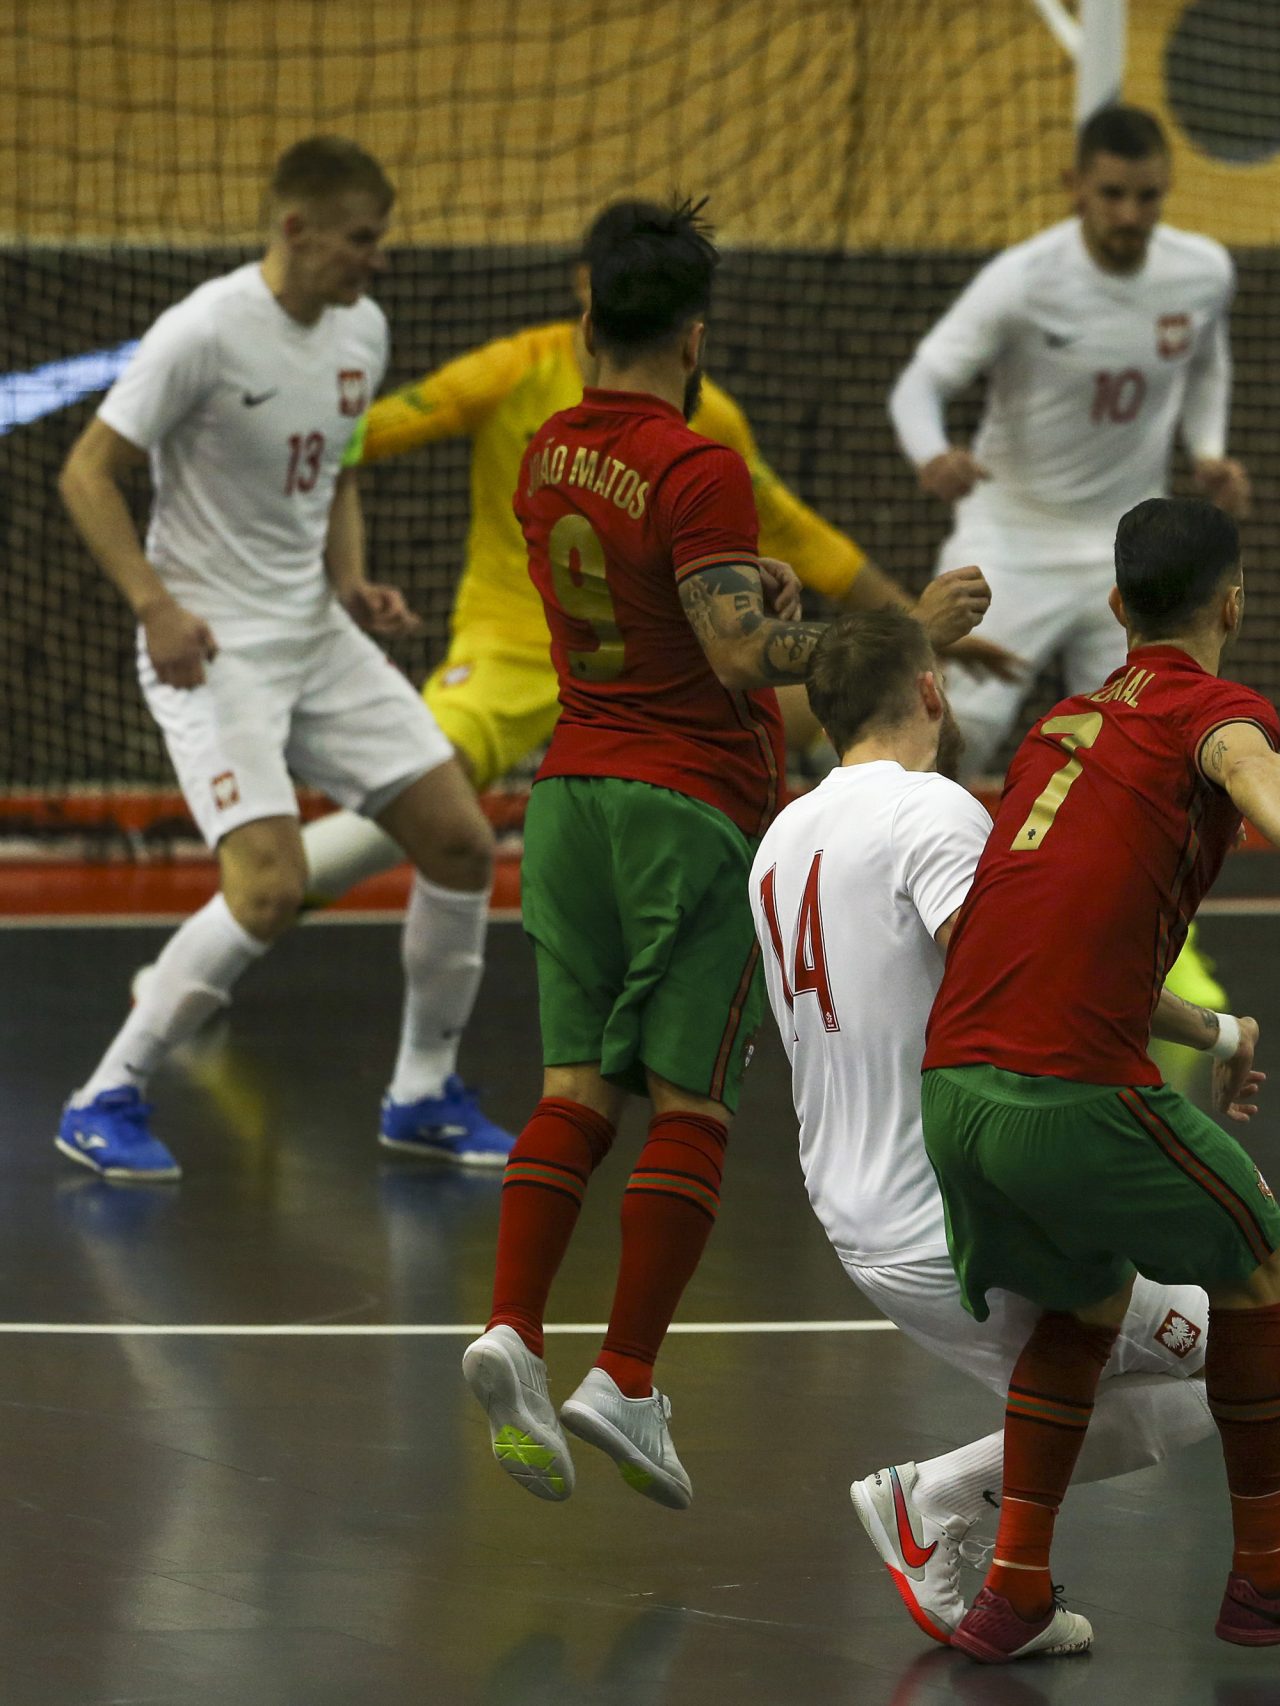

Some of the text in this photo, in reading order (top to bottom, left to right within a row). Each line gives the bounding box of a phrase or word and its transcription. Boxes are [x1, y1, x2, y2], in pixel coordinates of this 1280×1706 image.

[1090, 367, 1147, 425] 10
[284, 431, 325, 496] 13
[568, 446, 650, 519] MATOS
[549, 513, 625, 683] 9
[1010, 712, 1103, 851] 7
[760, 848, 841, 1042] 14
